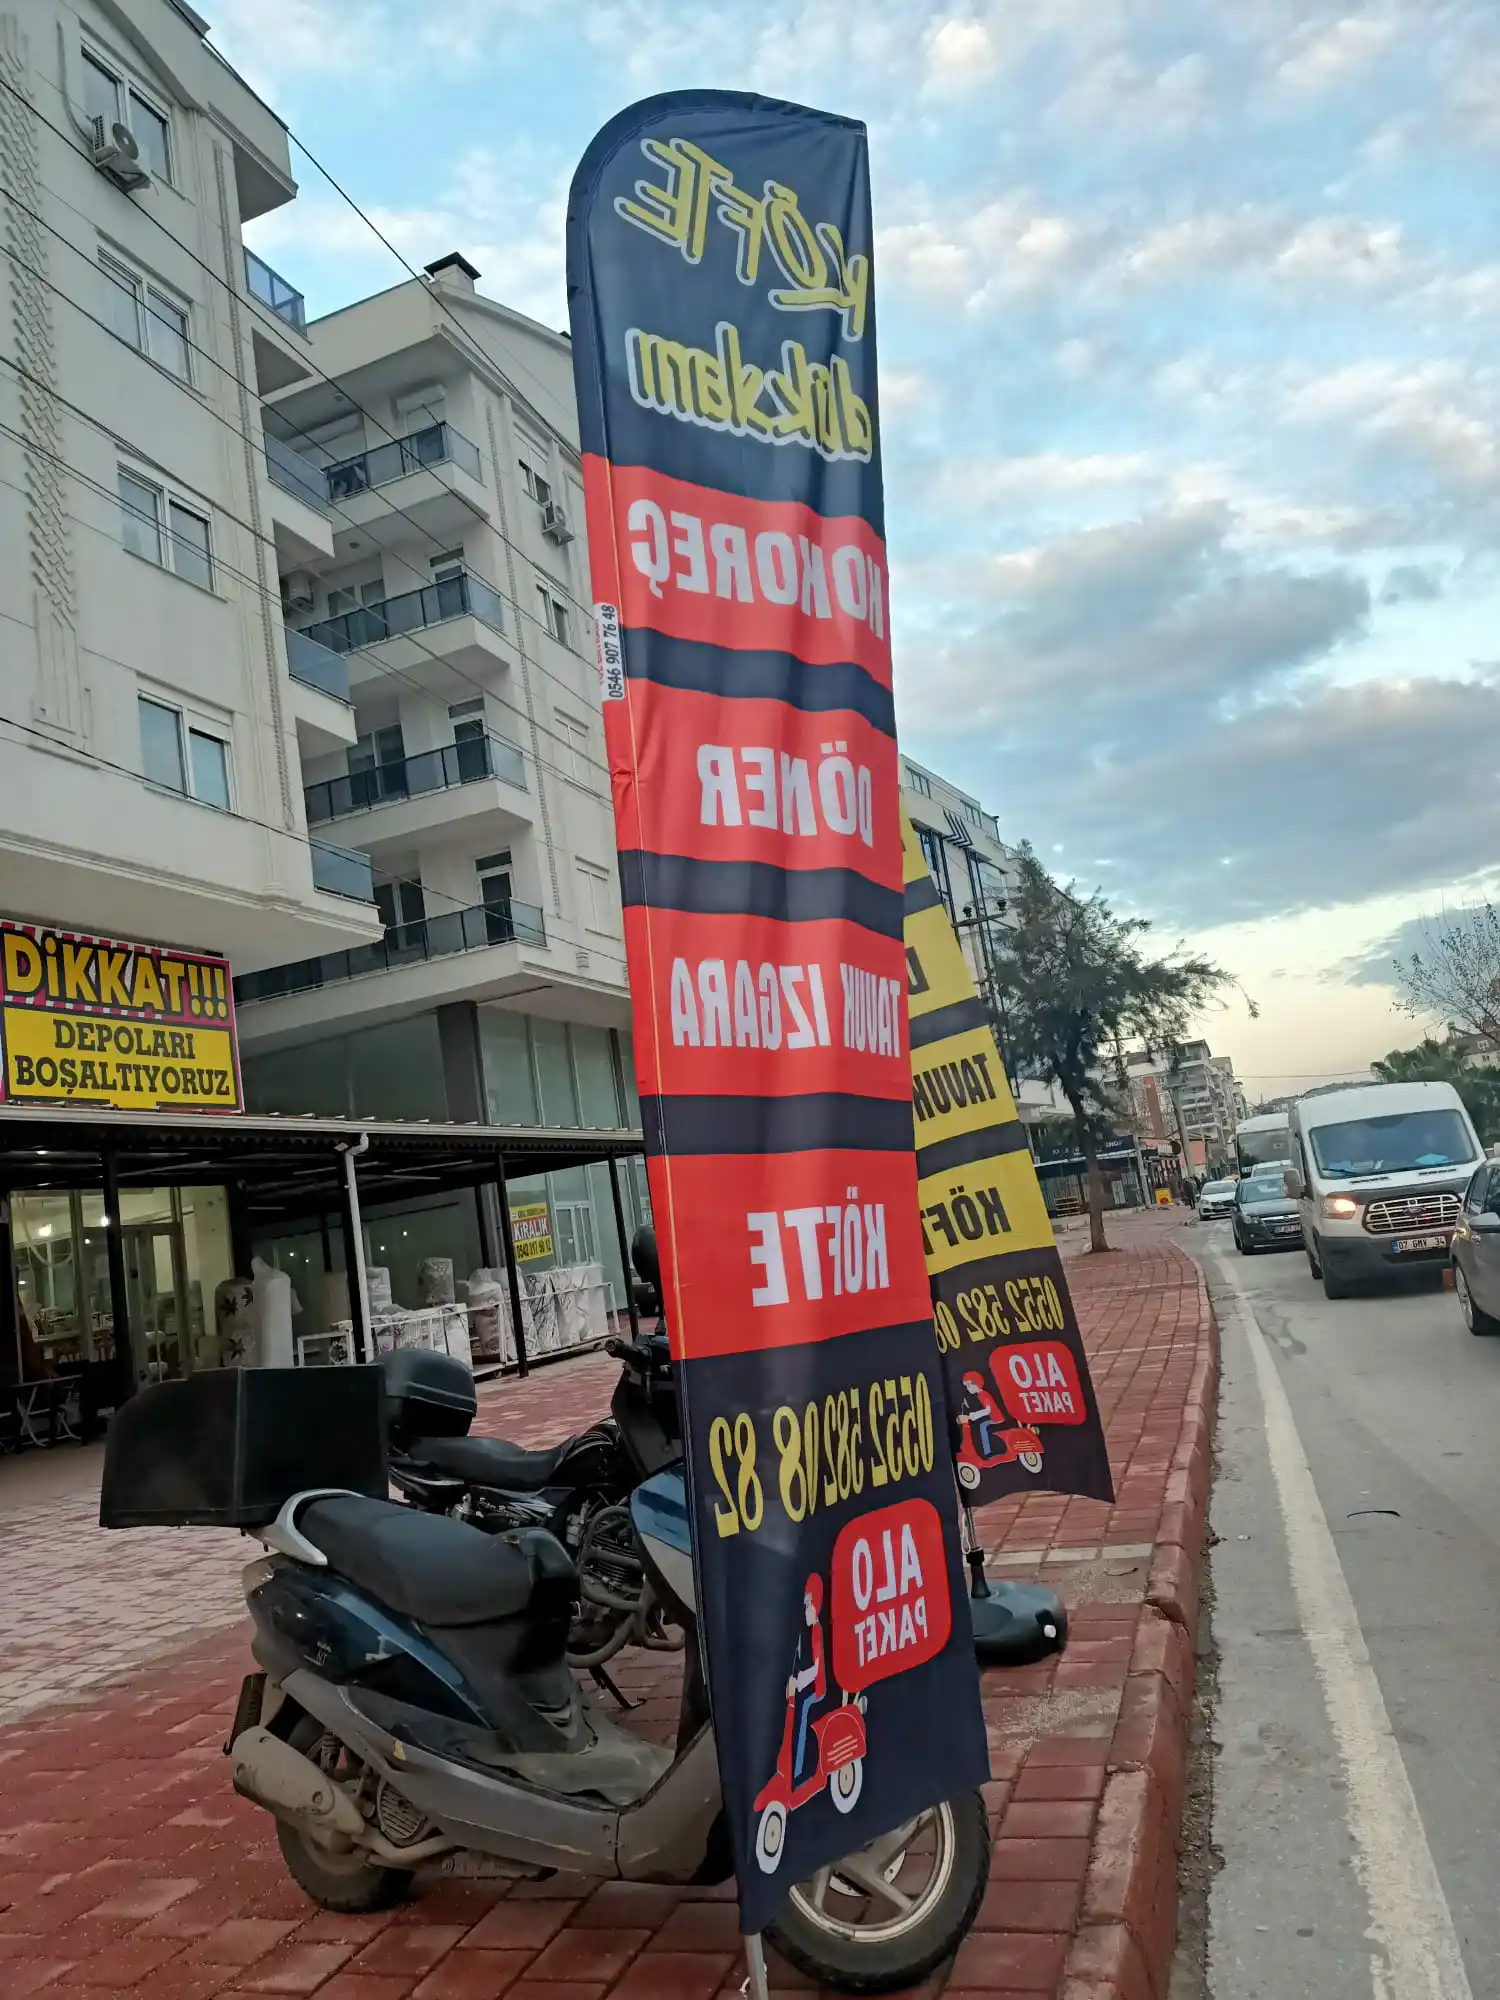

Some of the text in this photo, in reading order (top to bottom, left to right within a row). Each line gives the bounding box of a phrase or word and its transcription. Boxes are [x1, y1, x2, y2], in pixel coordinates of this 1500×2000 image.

[601, 604, 623, 698] 0546 907 76 48
[53, 1018, 196, 1059] DEPOLARI
[14, 1055, 230, 1095] BOŞALTIYORUZ
